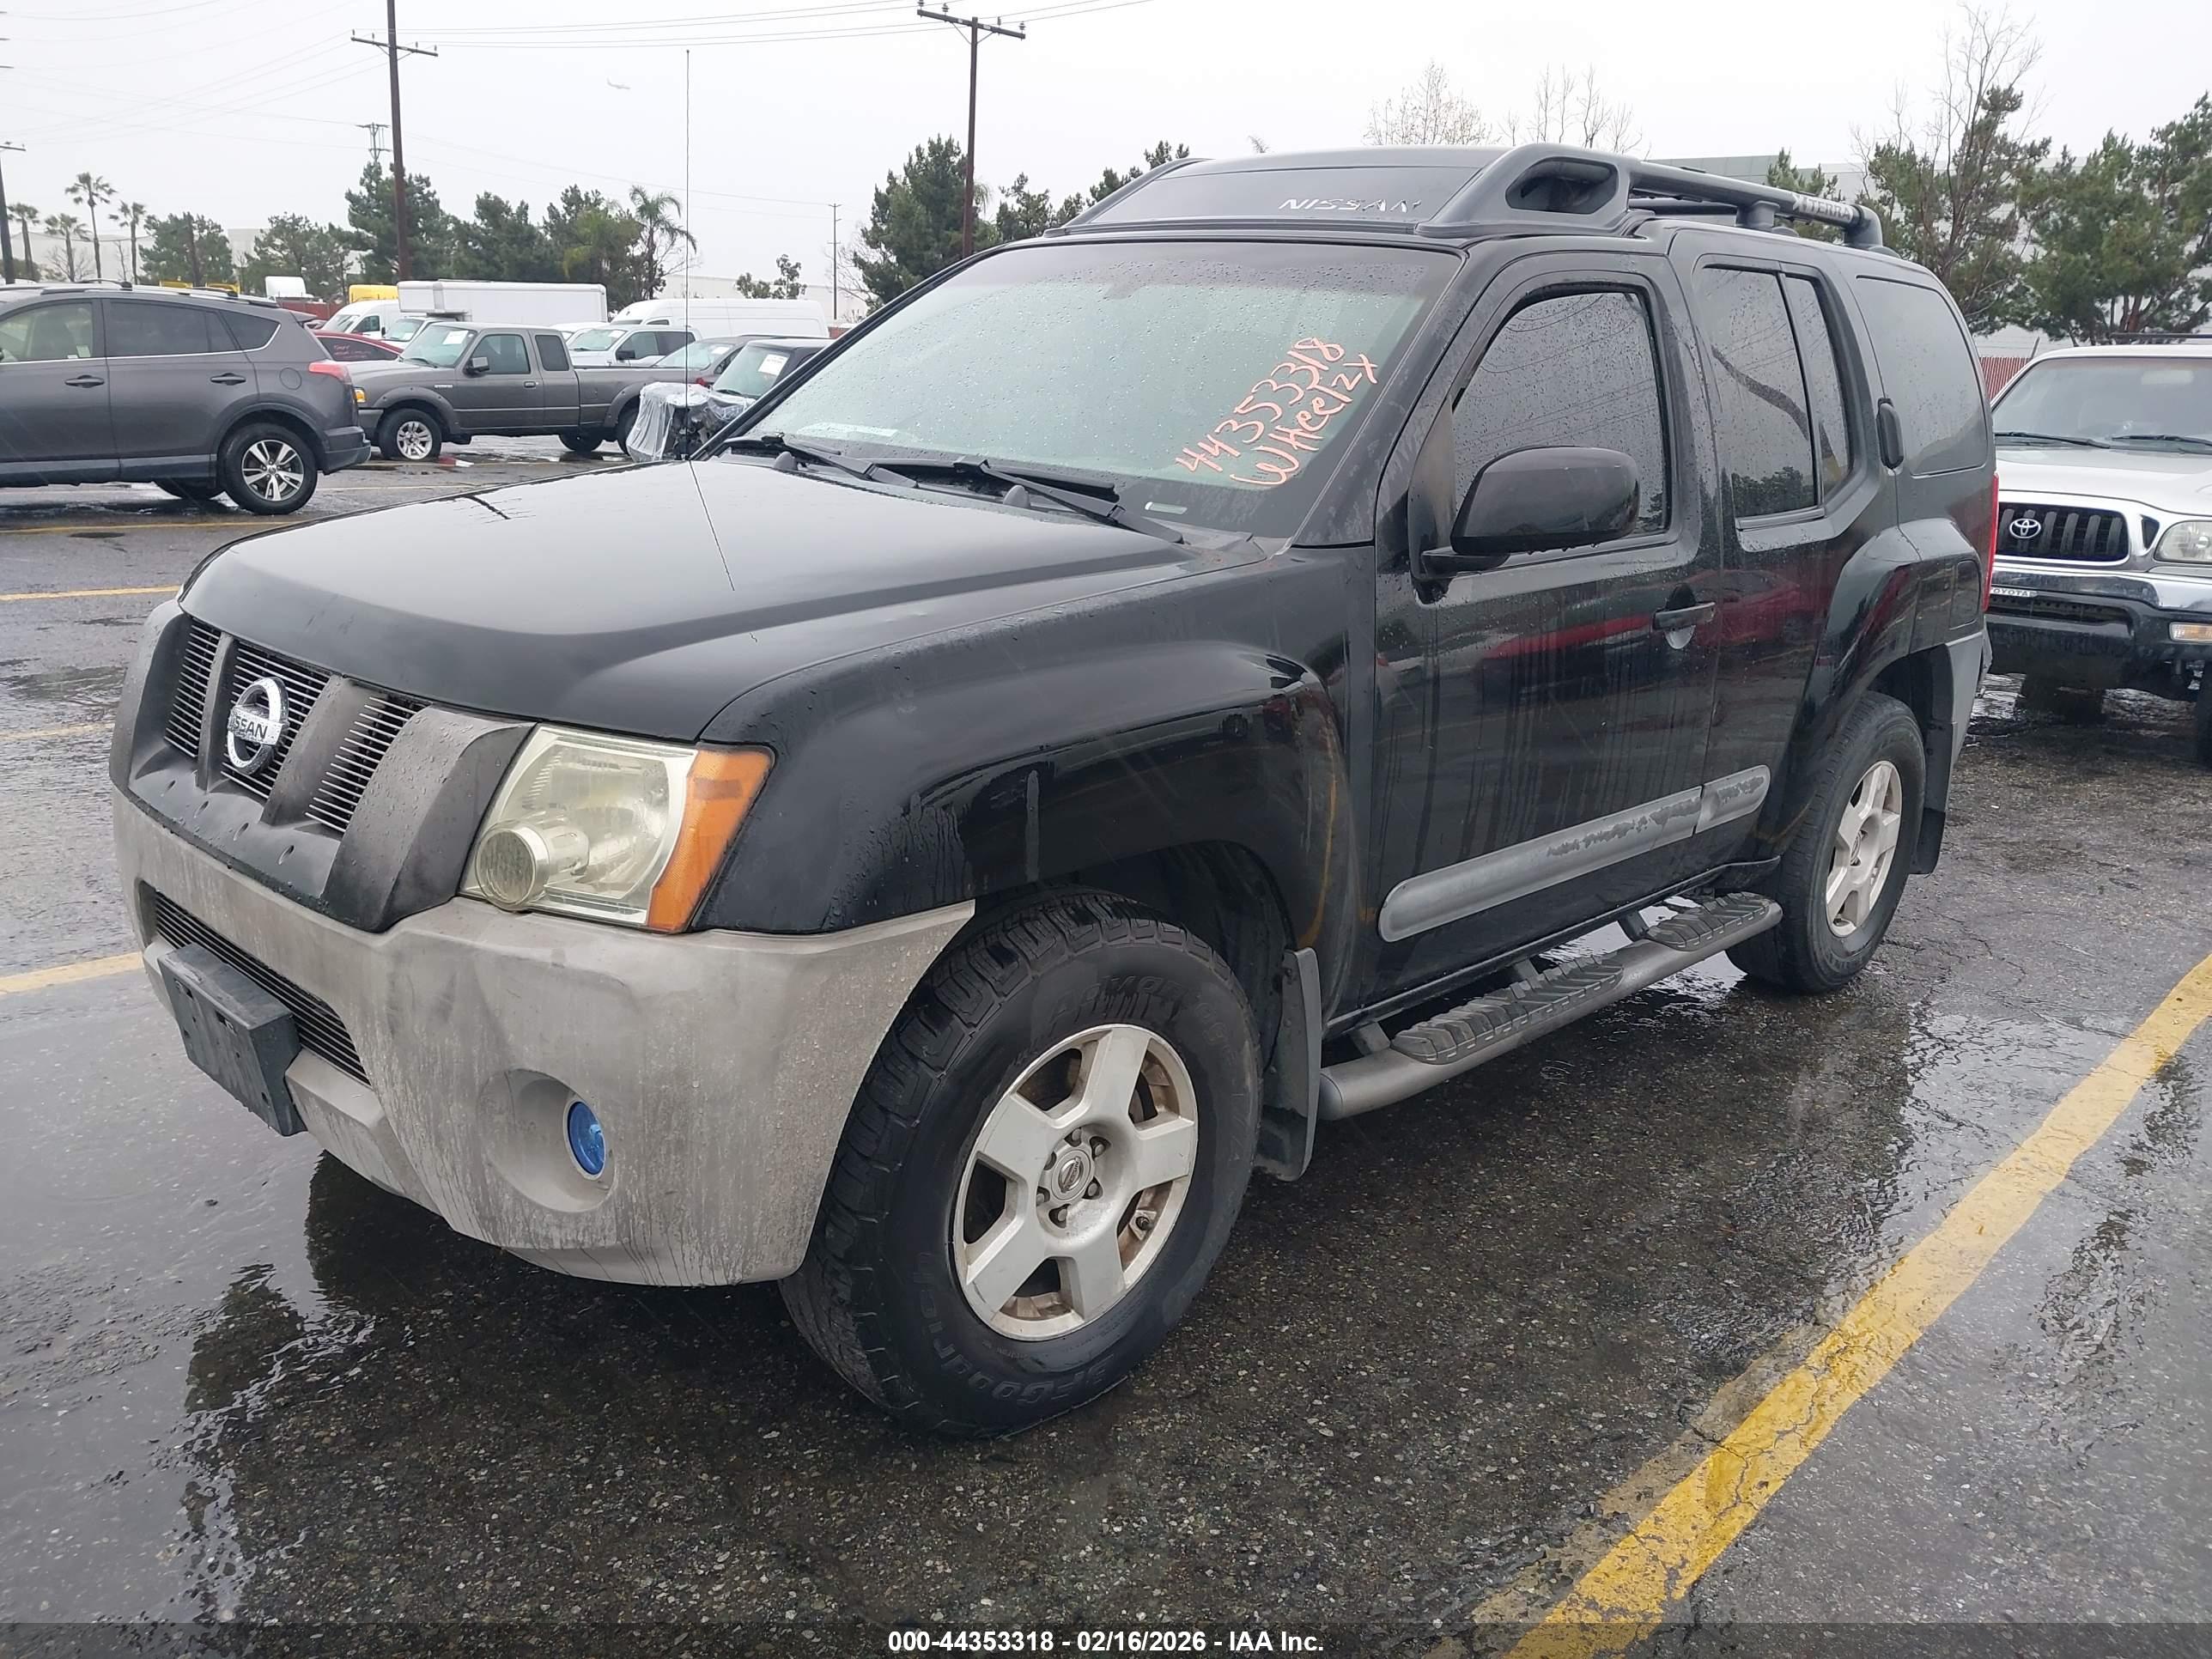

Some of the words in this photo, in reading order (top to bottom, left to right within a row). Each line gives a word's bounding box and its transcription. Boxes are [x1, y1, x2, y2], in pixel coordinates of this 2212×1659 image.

[1278, 198, 1423, 213] NISSAN
[1175, 337, 1346, 471] 44353318
[1992, 588, 2028, 597] OYOTA
